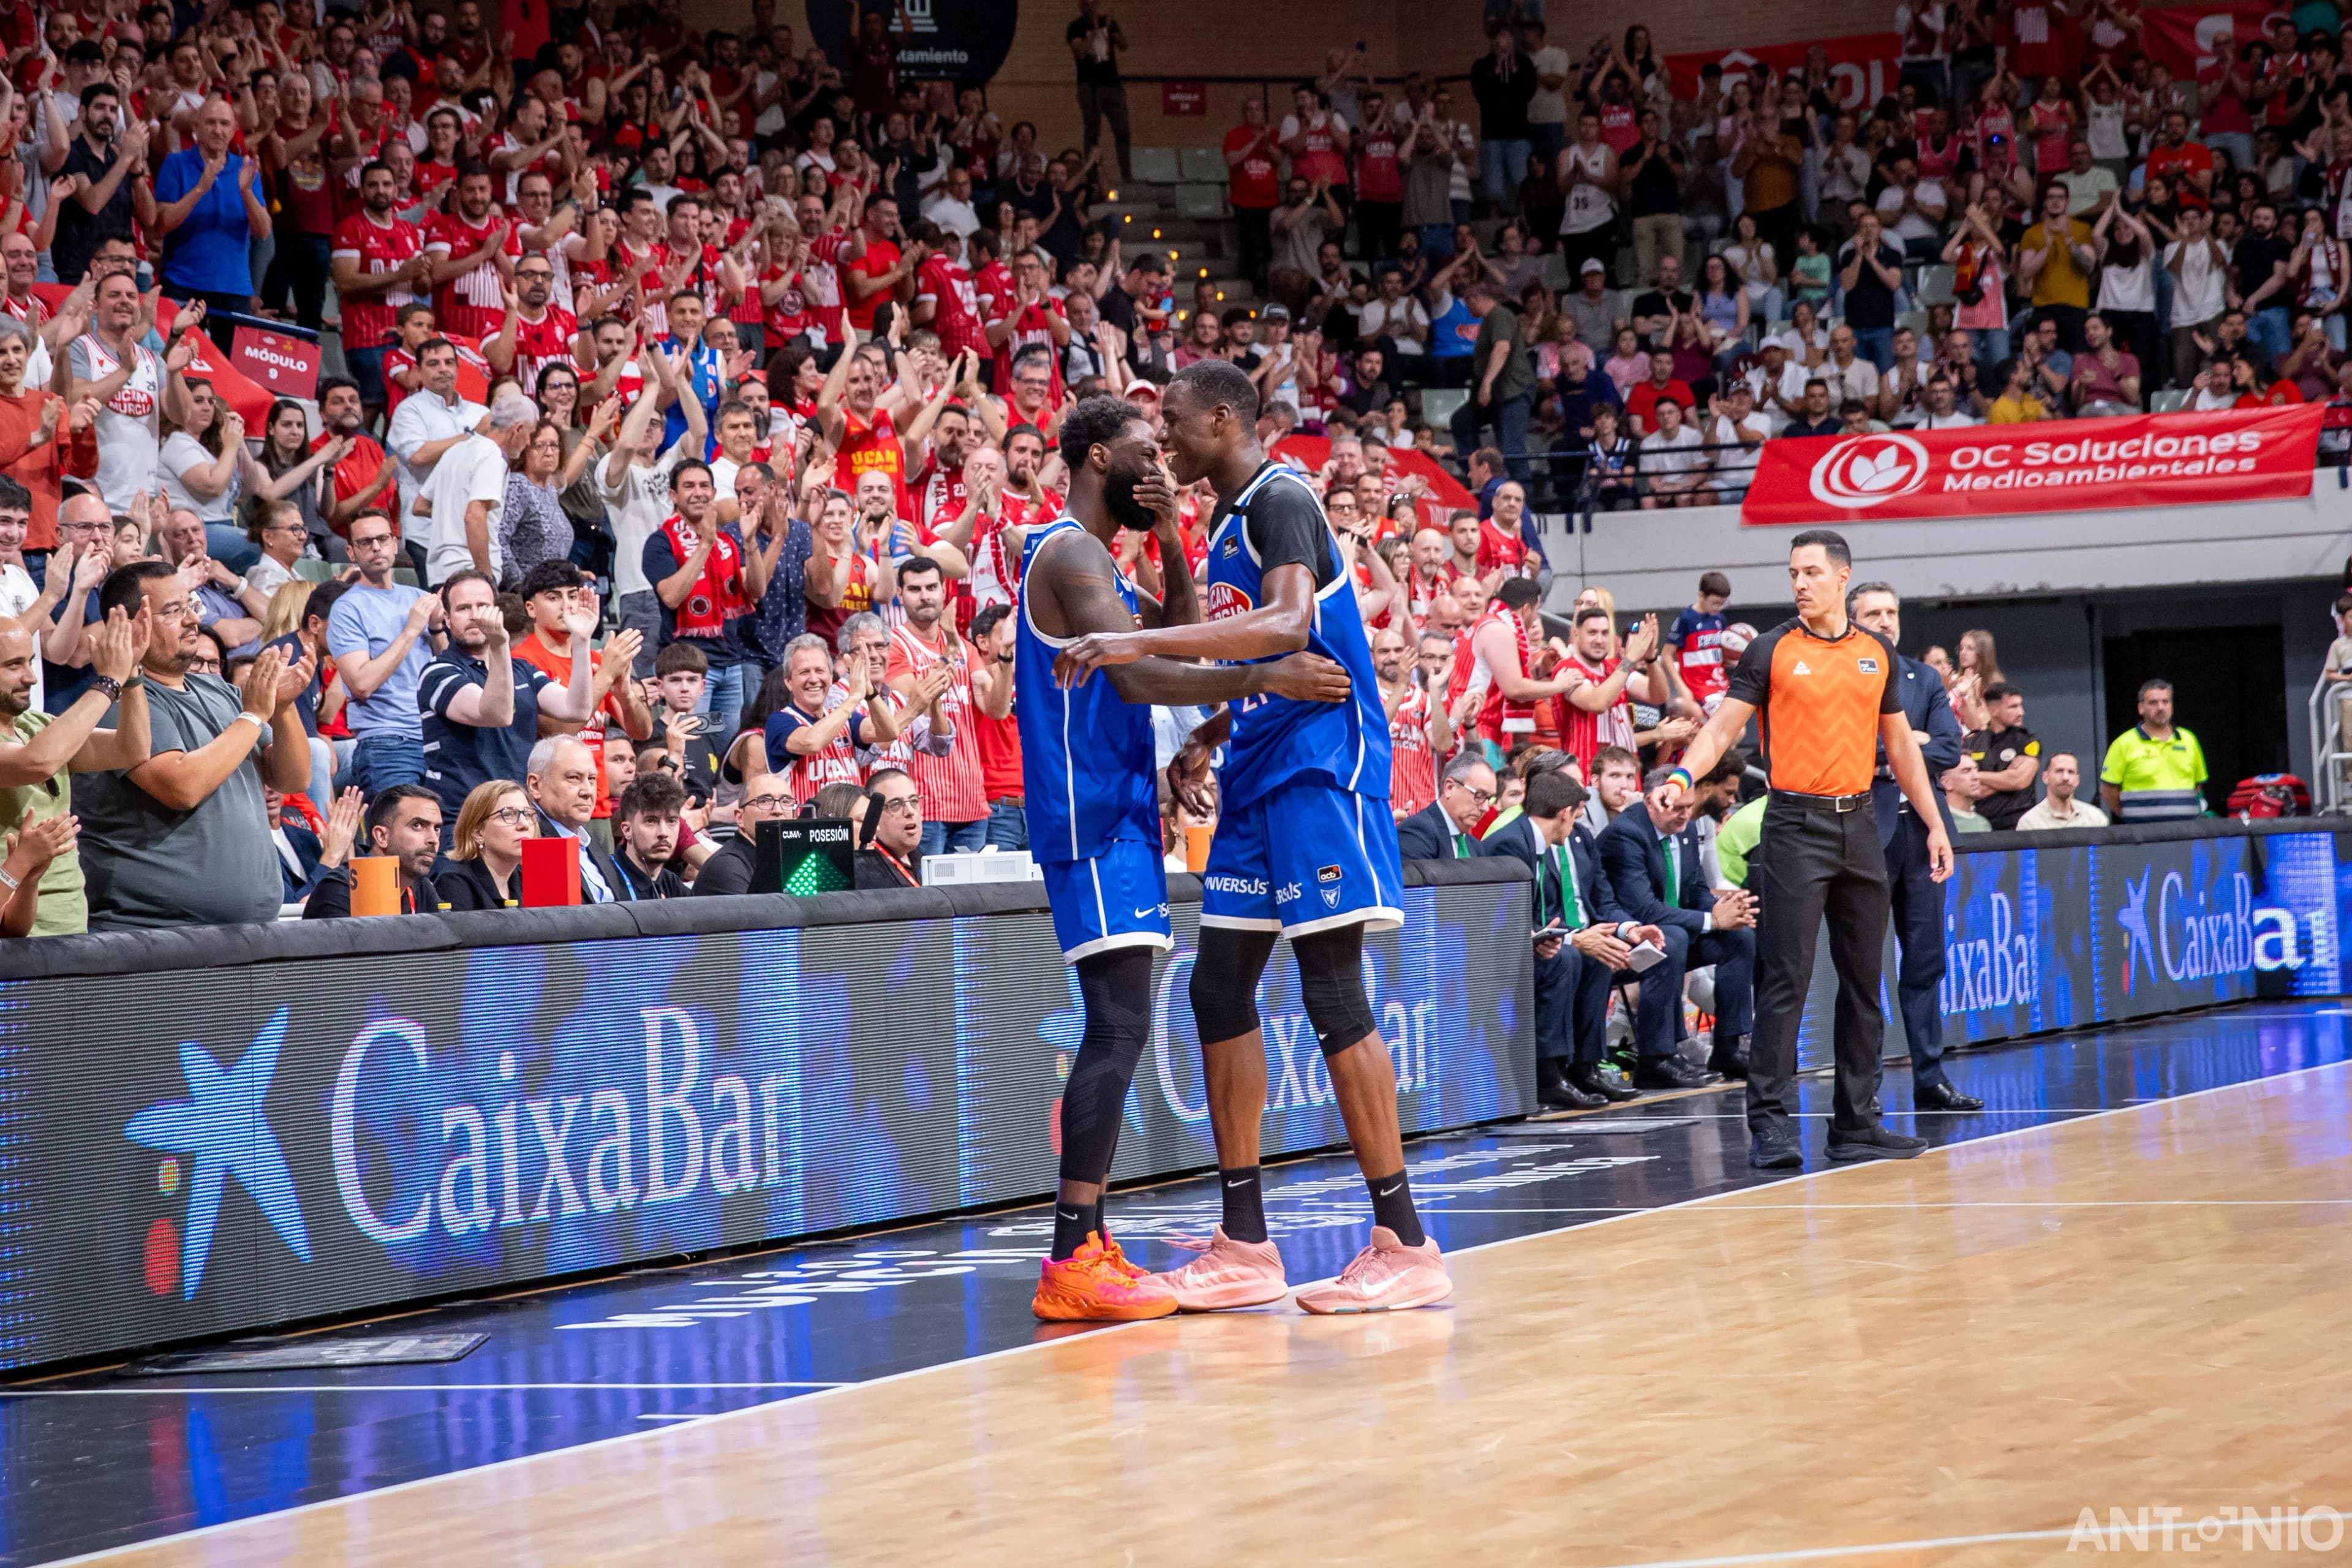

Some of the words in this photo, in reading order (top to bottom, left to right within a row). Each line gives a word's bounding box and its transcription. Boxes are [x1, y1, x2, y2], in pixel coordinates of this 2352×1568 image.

[896, 47, 968, 63] tamiento
[244, 345, 307, 372] MÓDULO
[268, 368, 278, 380] 9
[1950, 444, 2013, 470] OC
[2022, 430, 2262, 466] Soluciones
[1942, 455, 2256, 492] Medioambientales
[809, 825, 849, 843] POSESIÓN
[1320, 871, 1336, 881] acb
